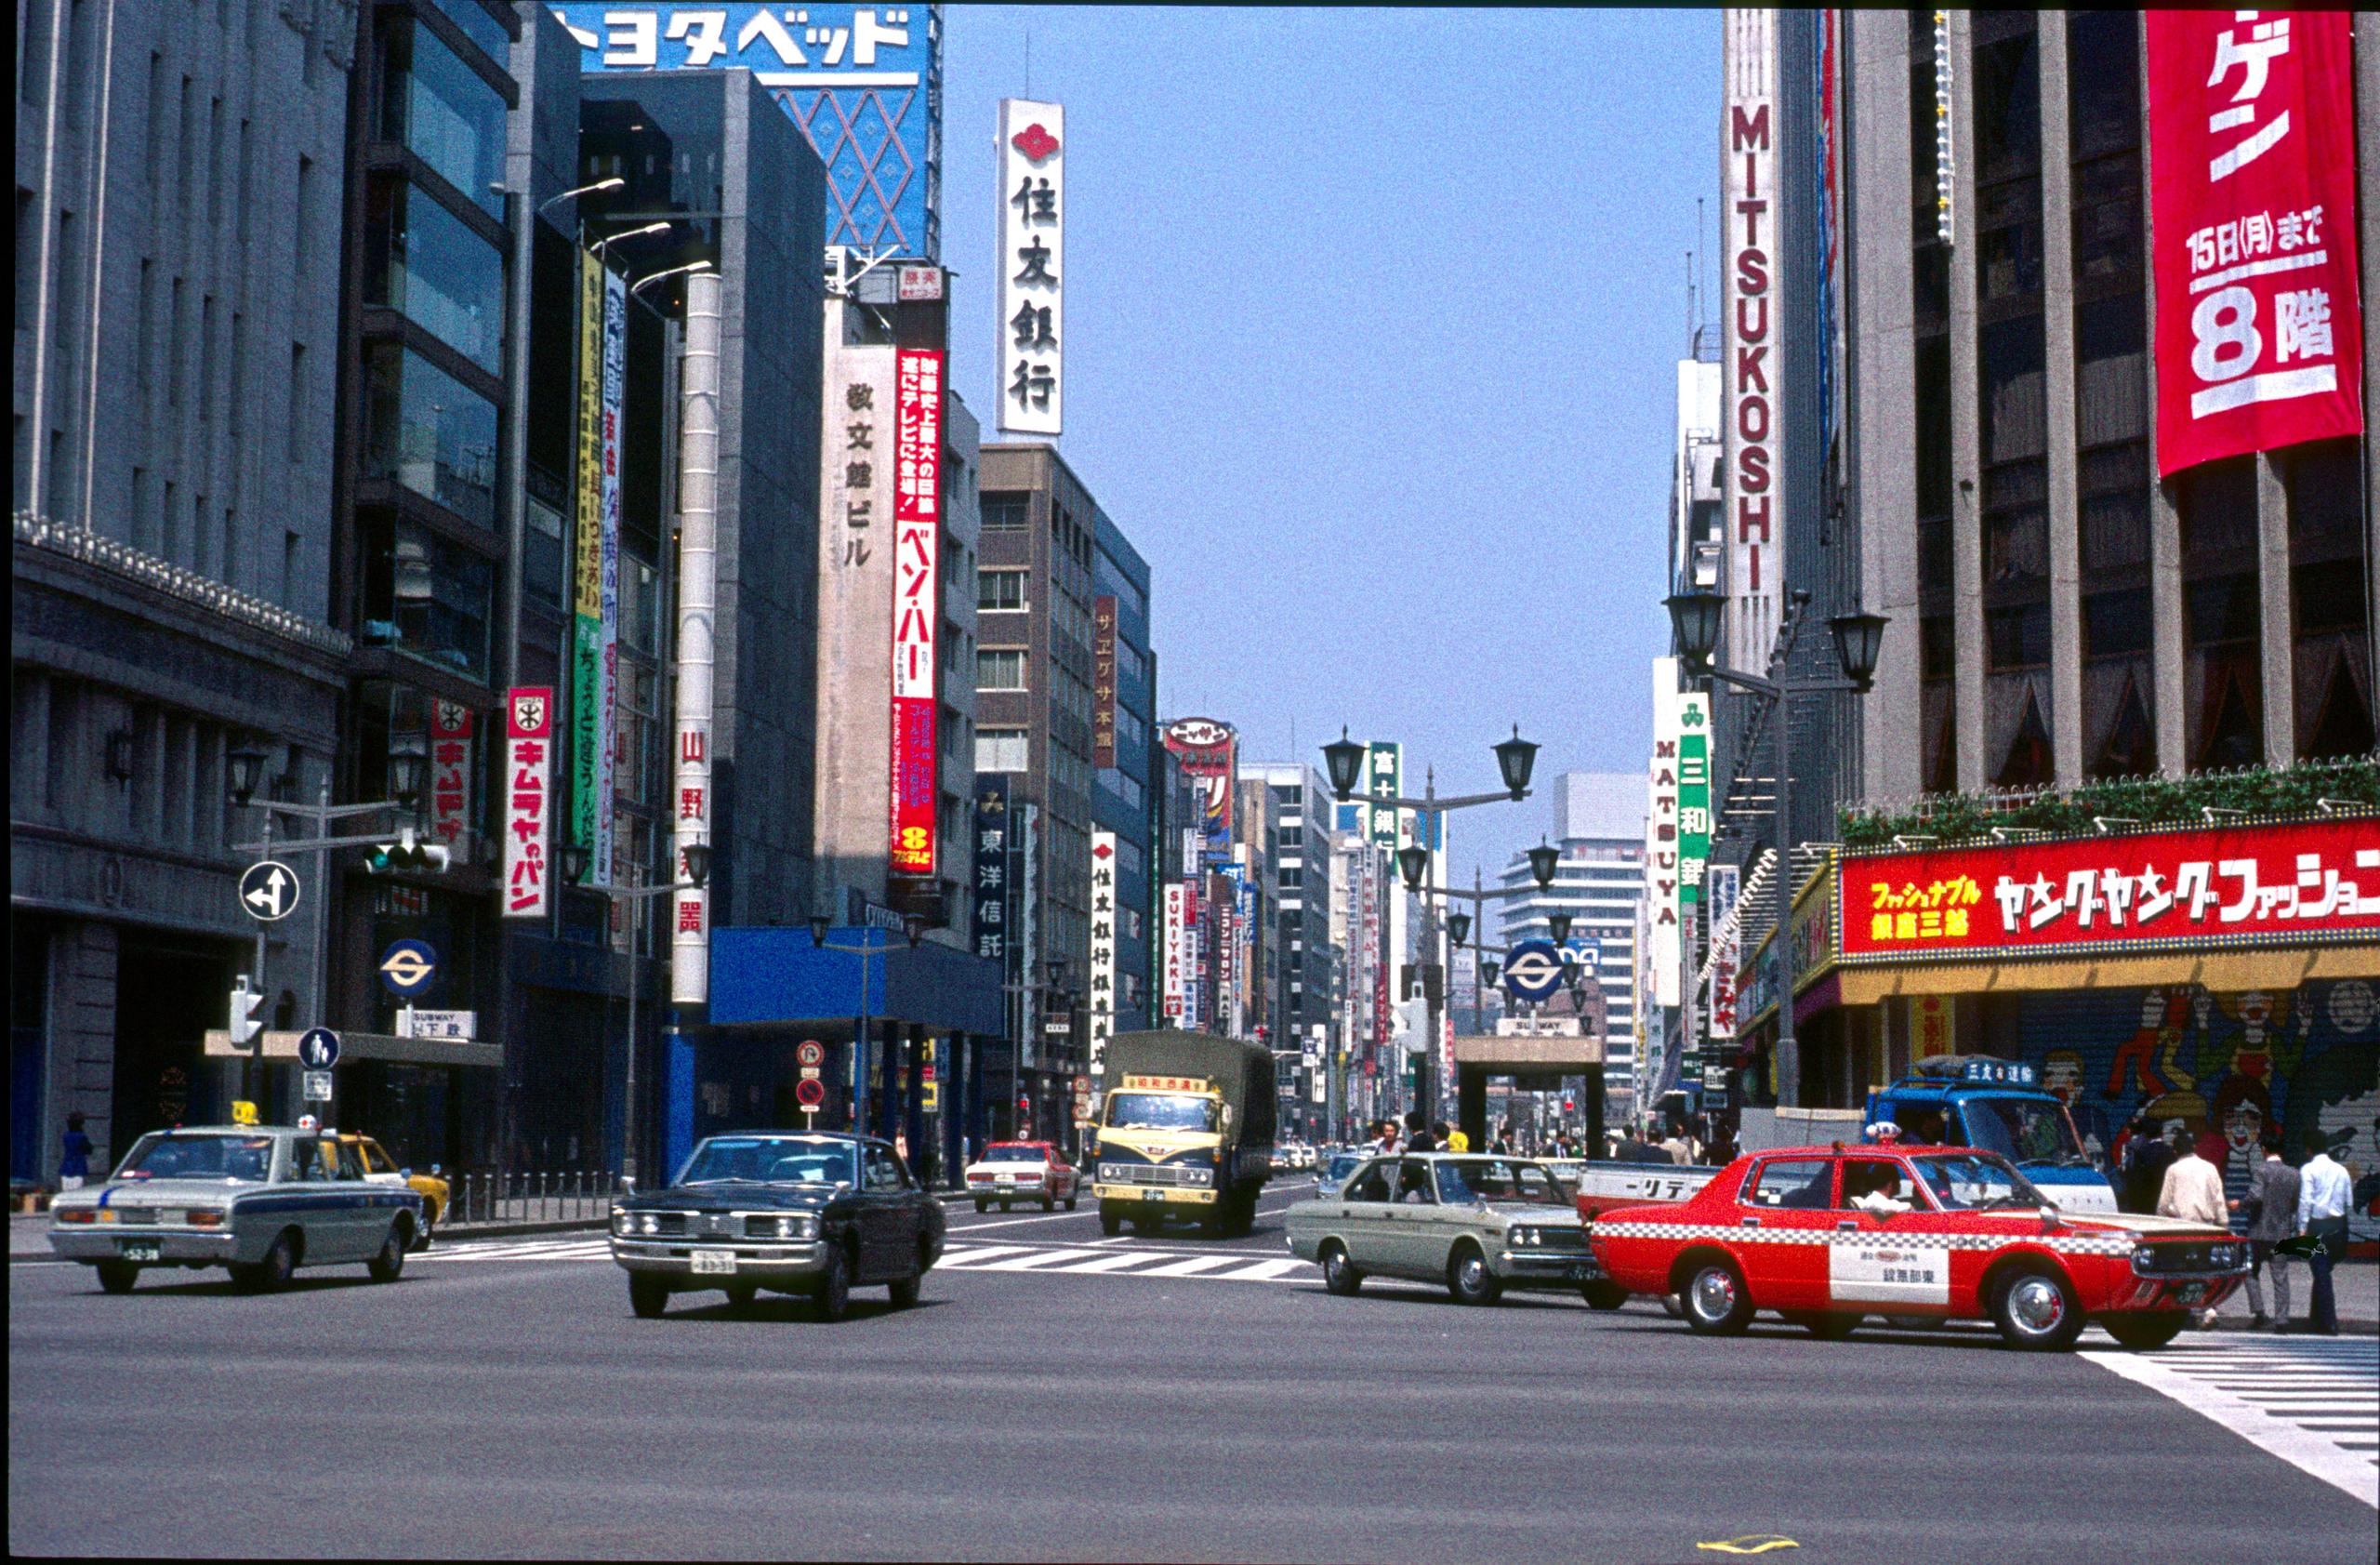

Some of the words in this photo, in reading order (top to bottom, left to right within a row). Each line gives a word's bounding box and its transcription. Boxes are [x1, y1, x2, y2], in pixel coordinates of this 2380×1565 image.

[2207, 9, 2291, 183] ゲン
[1010, 176, 1058, 412] 住友銀行
[1732, 104, 1770, 590] MITSUKOSHI
[2191, 286, 2334, 382] 8階
[845, 383, 872, 567] 教文館ビル
[511, 741, 544, 911] キムラヤのパン
[680, 731, 705, 931] 山野器
[979, 829, 1003, 958] 東洋信託
[1657, 741, 1676, 924] MATSUYA
[1871, 875, 1981, 909] ファッショナブル
[1170, 890, 1180, 991] SUKIYAKI
[1871, 908, 1969, 940] 銀座三越
[415, 1013, 455, 1022] SUBWAY
[1516, 1021, 1561, 1029] SUWAY
